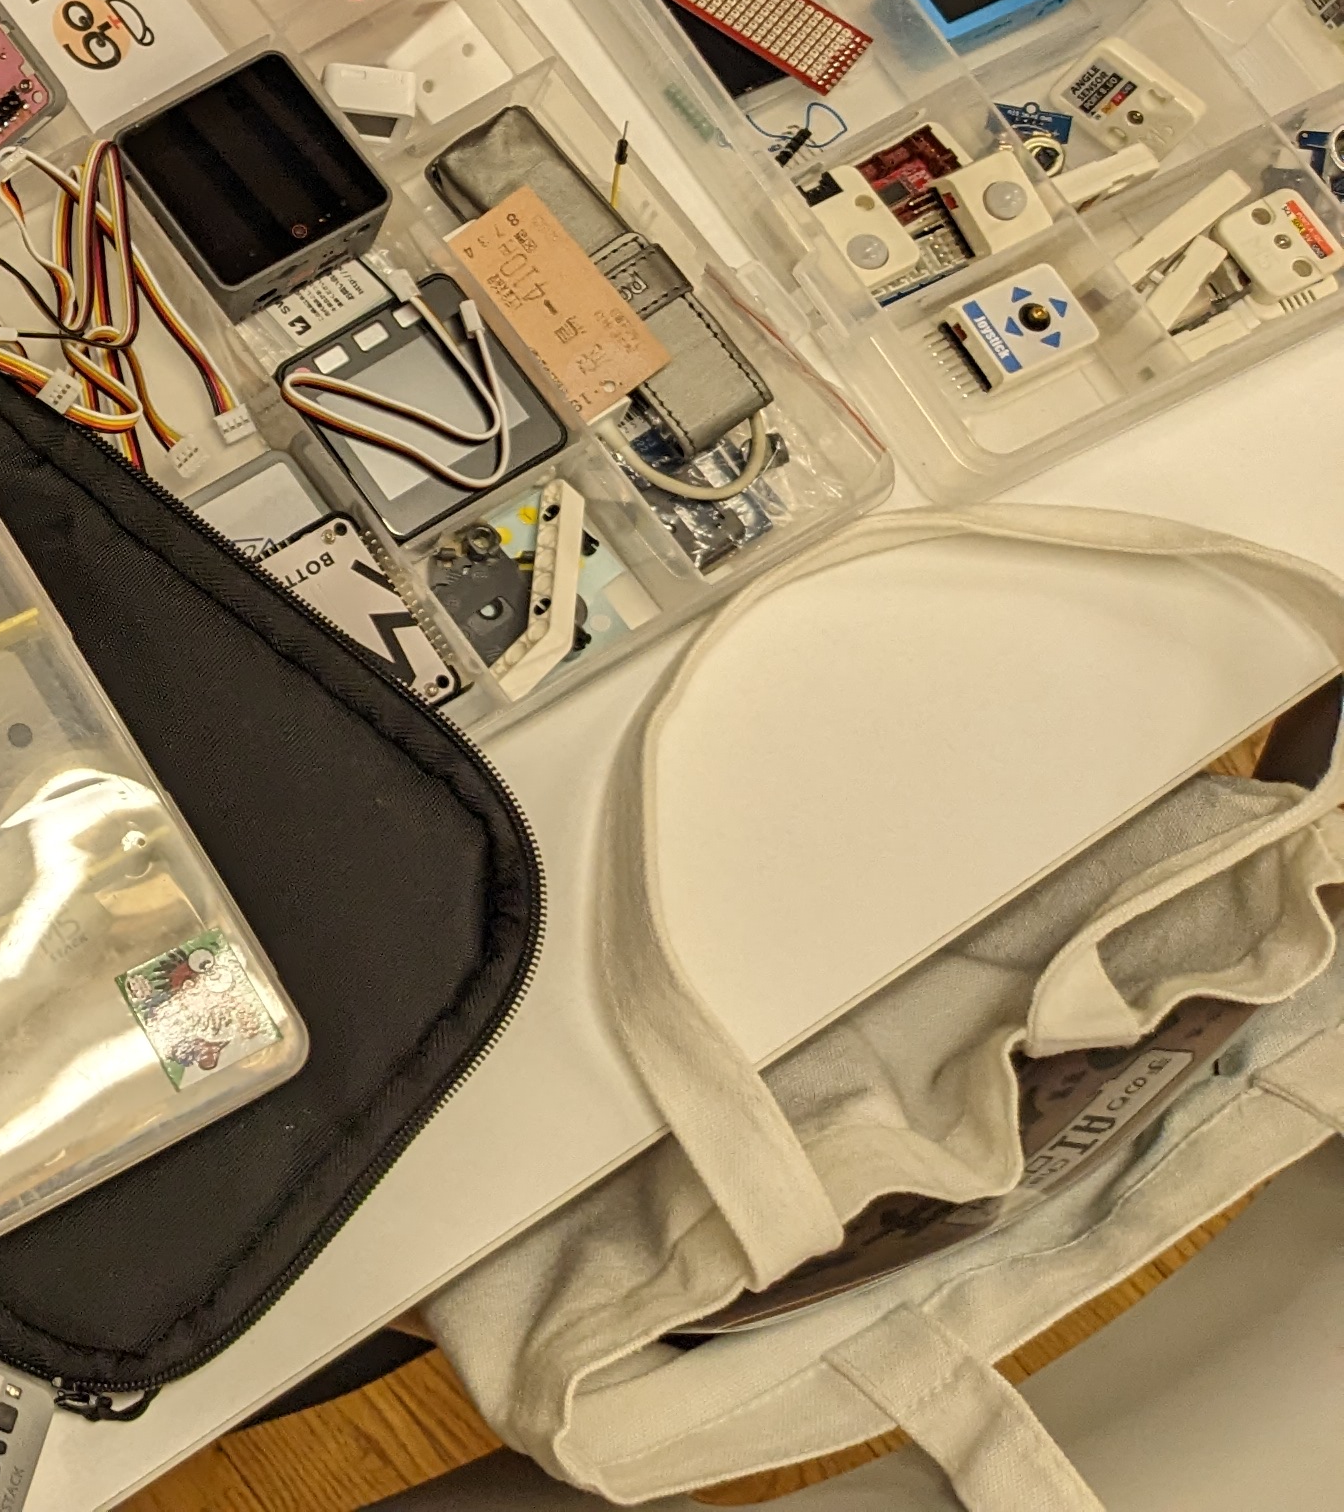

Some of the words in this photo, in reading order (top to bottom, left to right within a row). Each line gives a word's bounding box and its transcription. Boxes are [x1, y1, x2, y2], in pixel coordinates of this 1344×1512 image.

[1070, 64, 1101, 96] ANGLE
[1077, 71, 1109, 102] SENSOR
[973, 315, 1010, 359] Joystick
